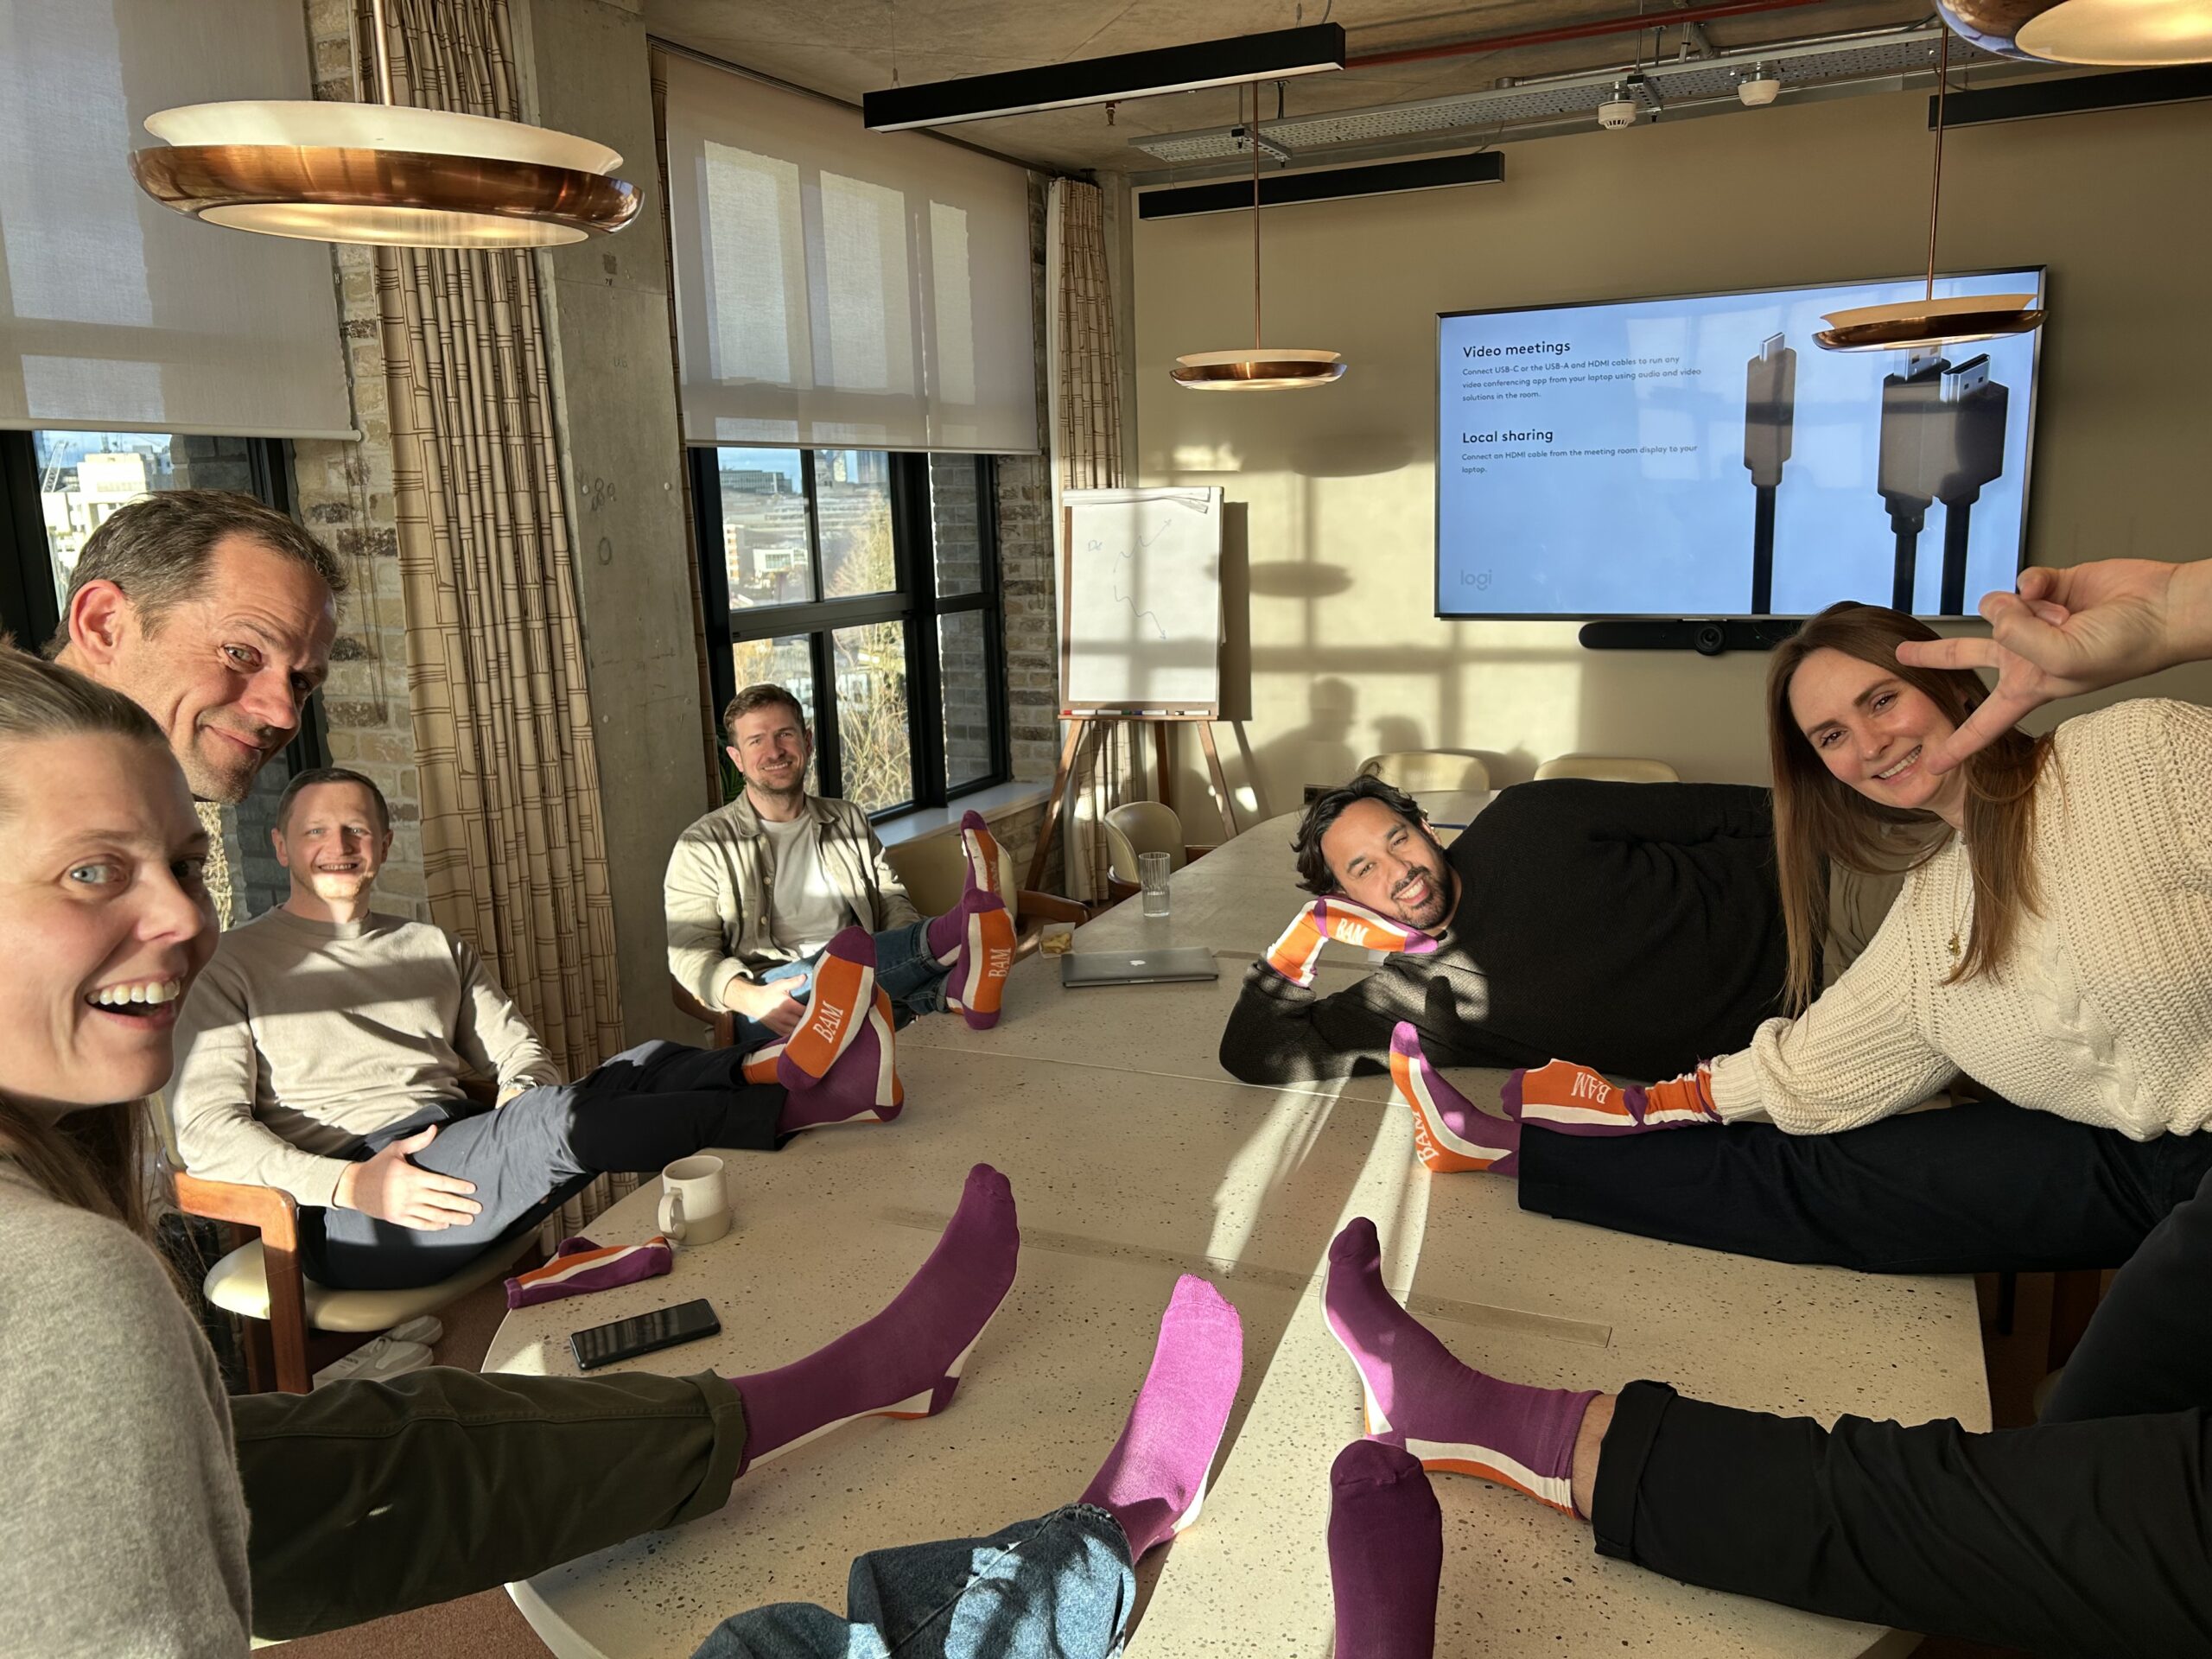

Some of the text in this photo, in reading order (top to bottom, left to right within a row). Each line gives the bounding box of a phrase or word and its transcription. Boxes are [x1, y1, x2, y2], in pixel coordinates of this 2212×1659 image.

[1462, 340, 1571, 358] Video meetings
[1495, 365, 1519, 374] USB-C
[1545, 362, 1570, 371] USB-A
[1664, 356, 1680, 365] any
[1568, 375, 1586, 384] your
[1587, 373, 1613, 383] laptop
[1615, 372, 1637, 381] using
[1680, 367, 1701, 376] video
[1462, 393, 1495, 402] solutions
[1462, 429, 1554, 443] Local sharing
[1584, 448, 1616, 457] meeting
[1639, 446, 1669, 455] display
[1680, 445, 1699, 454] your
[1460, 569, 1493, 591] logi
[1335, 918, 1370, 946] BAM
[988, 947, 1012, 978] BAM
[812, 1000, 844, 1044] BAM
[1571, 1071, 1611, 1104] BAM
[1412, 1110, 1440, 1162] BAM
